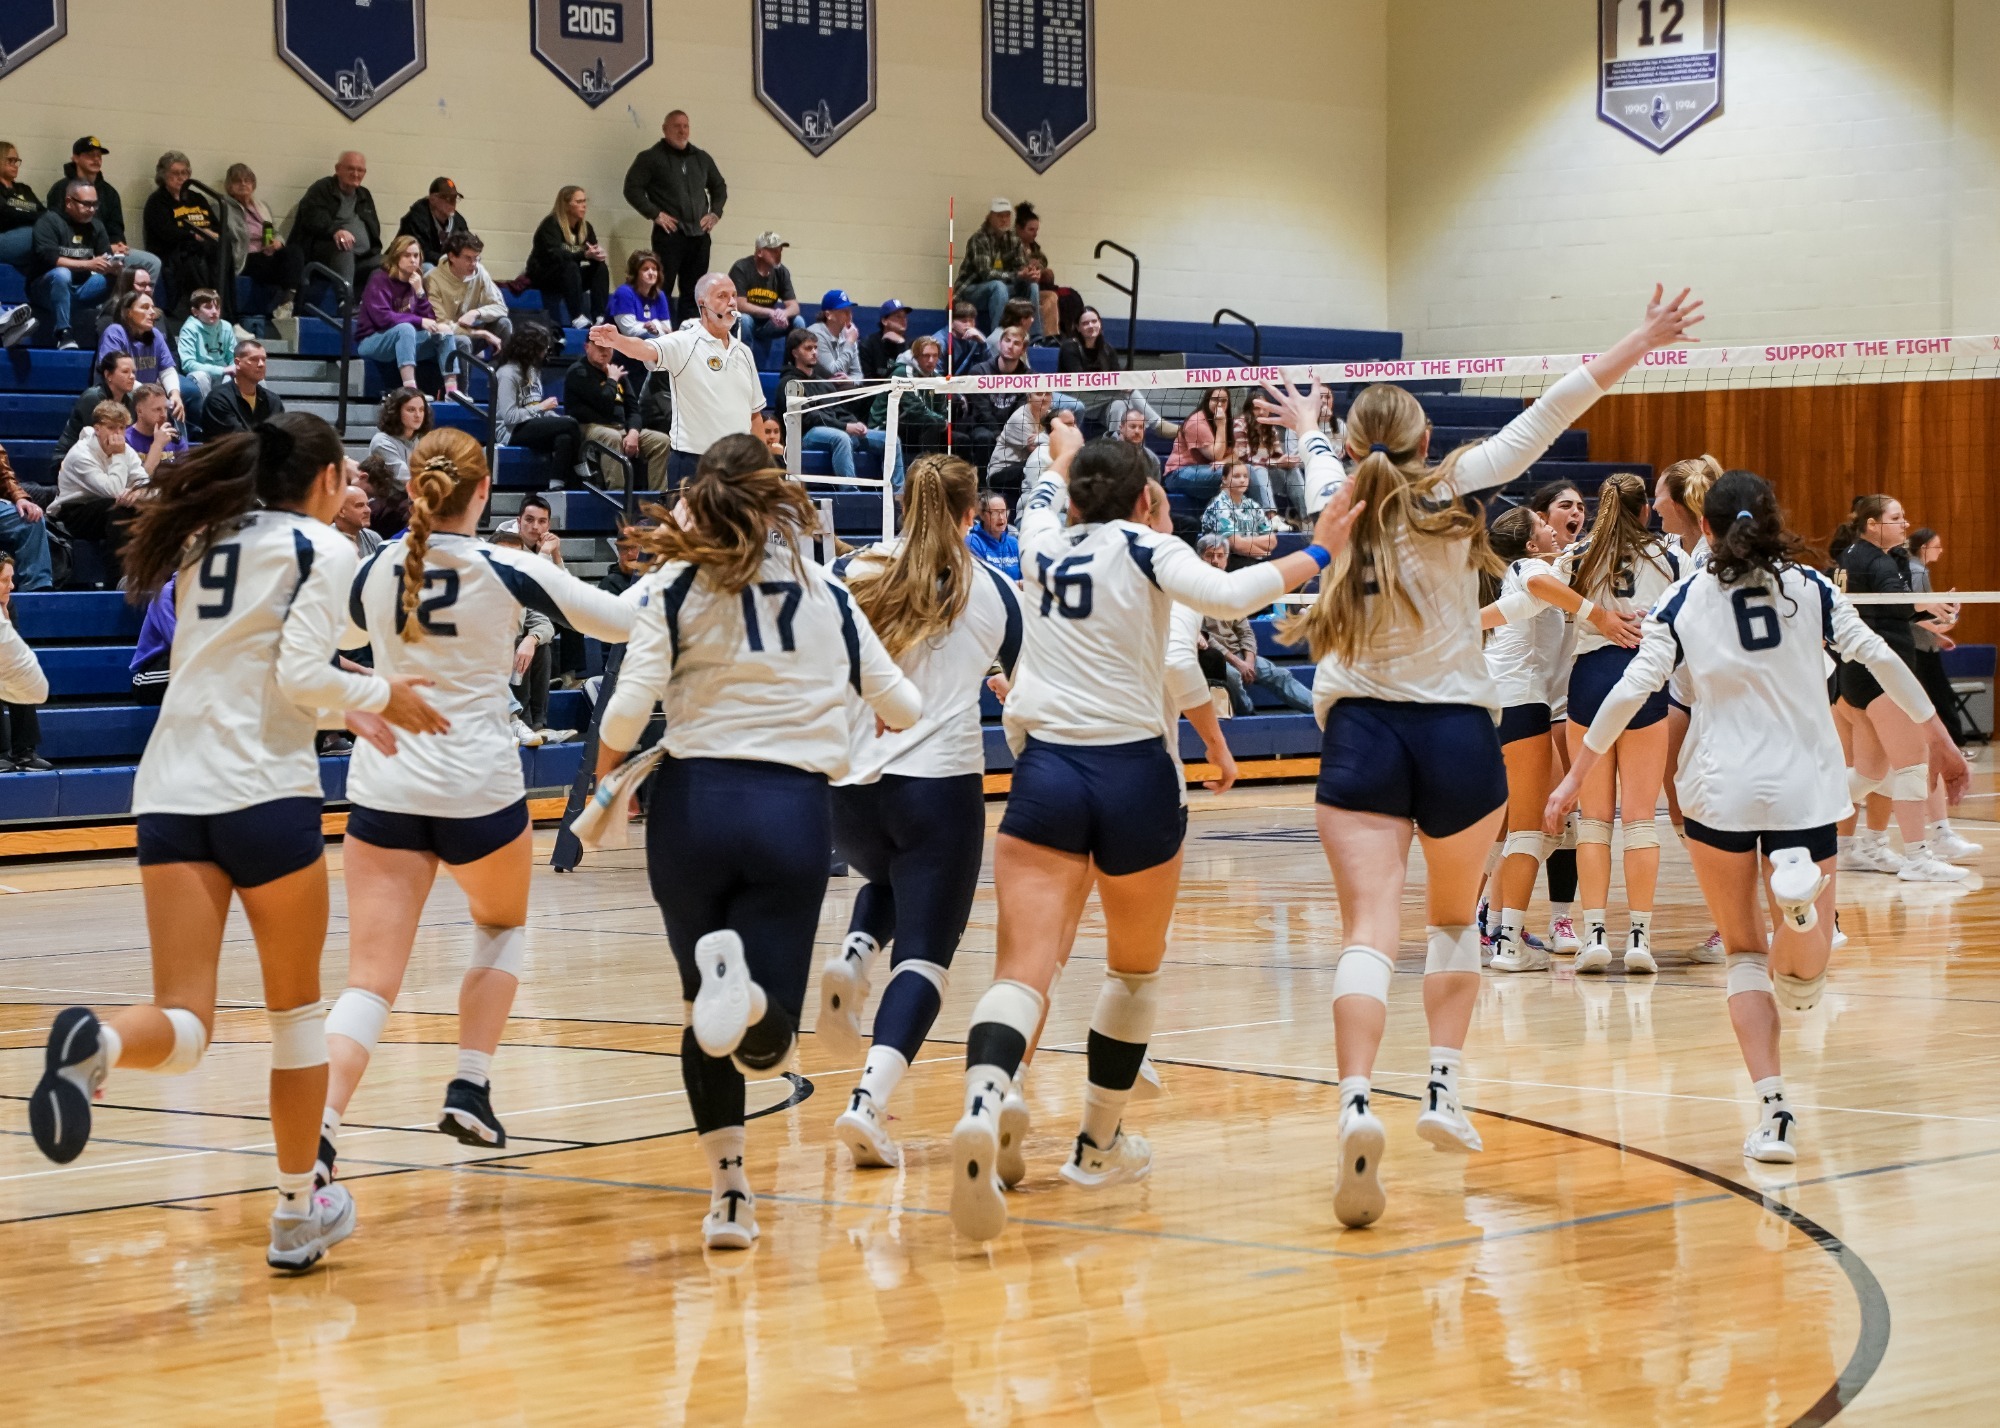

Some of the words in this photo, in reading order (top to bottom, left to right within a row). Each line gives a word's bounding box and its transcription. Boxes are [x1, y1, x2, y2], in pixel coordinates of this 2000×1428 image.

[567, 5, 616, 36] 2005
[1638, 0, 1684, 46] 12
[1624, 103, 1648, 115] 1990
[1675, 100, 1696, 110] 1994
[1582, 354, 1598, 366] FI
[1644, 350, 1688, 366] CURE
[1765, 343, 1848, 361] SUPPORT
[1853, 341, 1889, 356] THE
[1896, 338, 1953, 355] FIGHT
[977, 375, 1041, 390] SUPPORT
[1045, 374, 1072, 388] THE
[1077, 373, 1120, 387] FIGHT
[1186, 369, 1222, 383] FIND
[1226, 368, 1237, 381] A
[1240, 367, 1279, 381] CURE
[1344, 361, 1418, 378] SUPPORT
[1421, 360, 1451, 375] THE
[1457, 358, 1507, 374] FIGHT
[198, 543, 242, 619] 9
[1036, 551, 1094, 619] 16
[394, 564, 459, 637] 12
[741, 581, 803, 653] 17
[1731, 586, 1782, 653] 6
